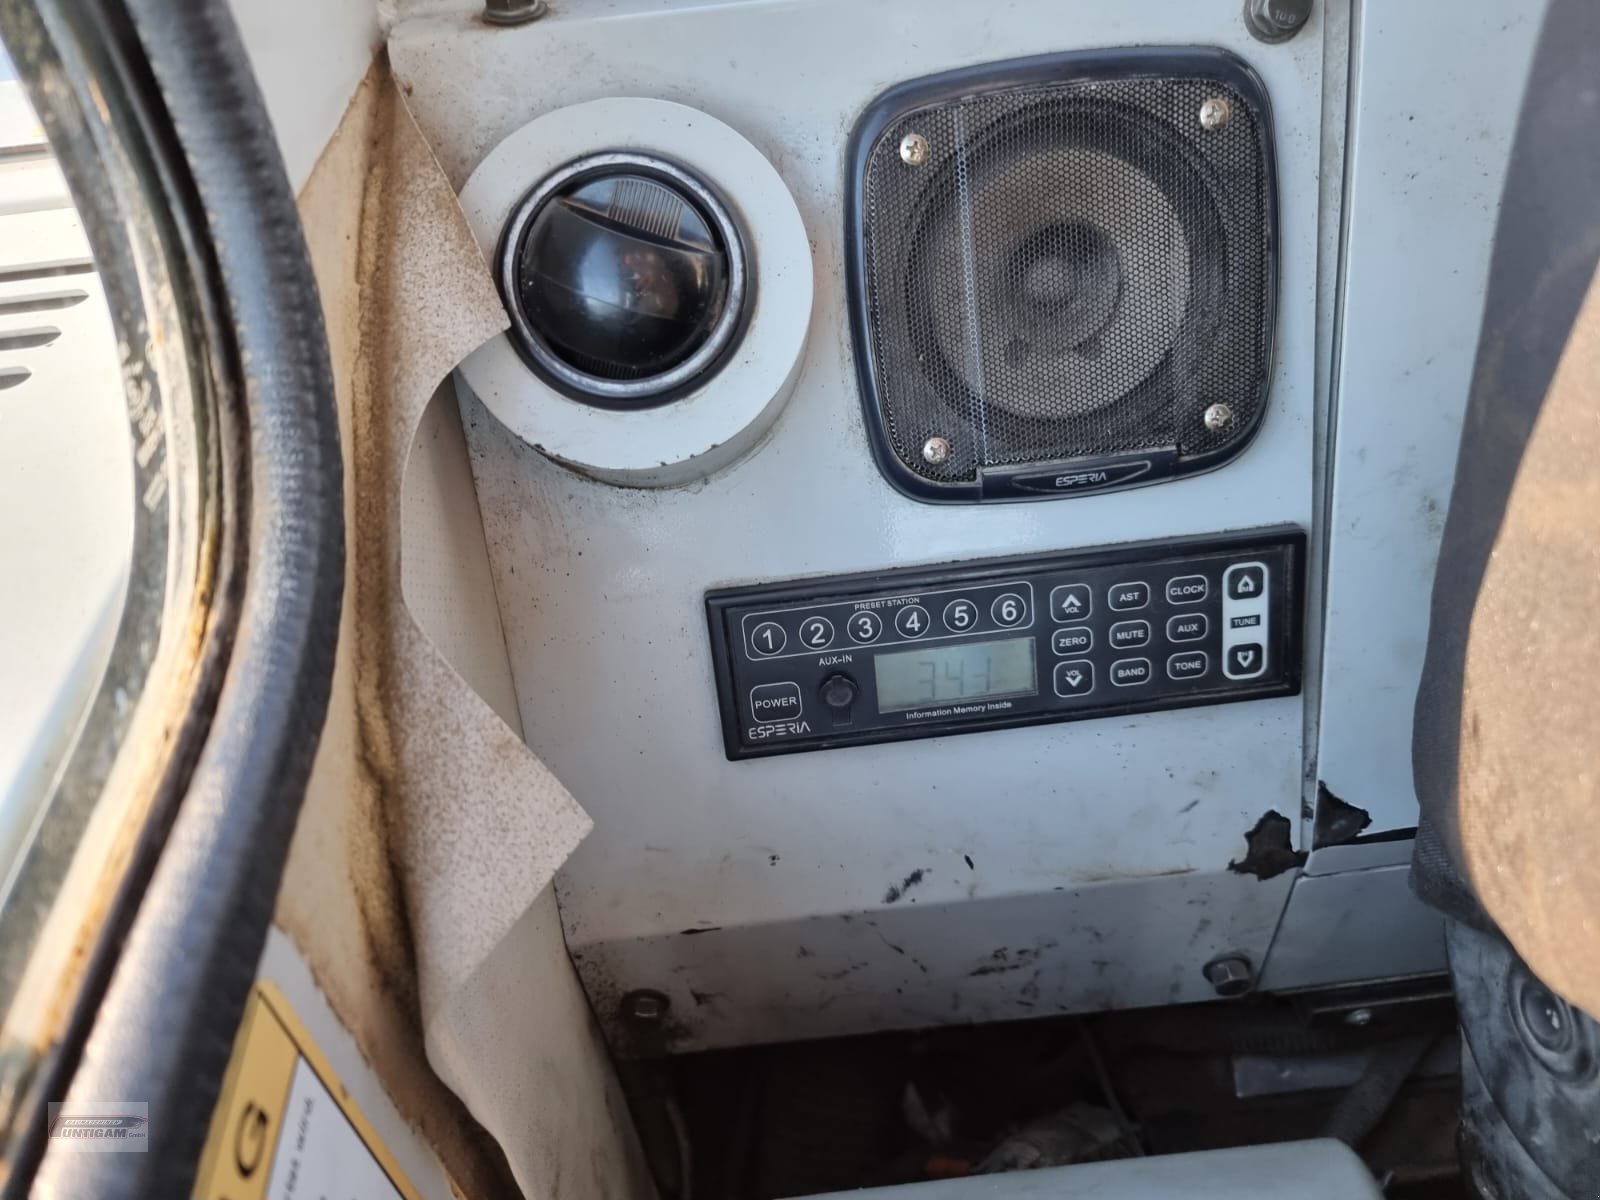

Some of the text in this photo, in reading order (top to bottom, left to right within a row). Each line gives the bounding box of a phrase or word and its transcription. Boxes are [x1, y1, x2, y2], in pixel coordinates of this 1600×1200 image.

[1055, 471, 1107, 487] ESPERIA
[1169, 583, 1205, 596] CLOCK
[1119, 591, 1140, 602] AST
[854, 596, 920, 611] PRESET STATION
[1064, 606, 1080, 614] VOL
[762, 599, 1018, 650] 1 2 3 4 5 6
[1233, 616, 1258, 627] TUNE
[1177, 623, 1199, 634] AUX
[1116, 629, 1145, 641] MUTE
[1058, 636, 1087, 648] ZERO
[818, 654, 853, 667] AUX-IN
[1174, 661, 1202, 672] TONE
[1117, 667, 1146, 679] BAND
[754, 696, 798, 710] POWER
[905, 701, 1013, 721] Information Memory Inside
[748, 721, 812, 740] ESPERIA
